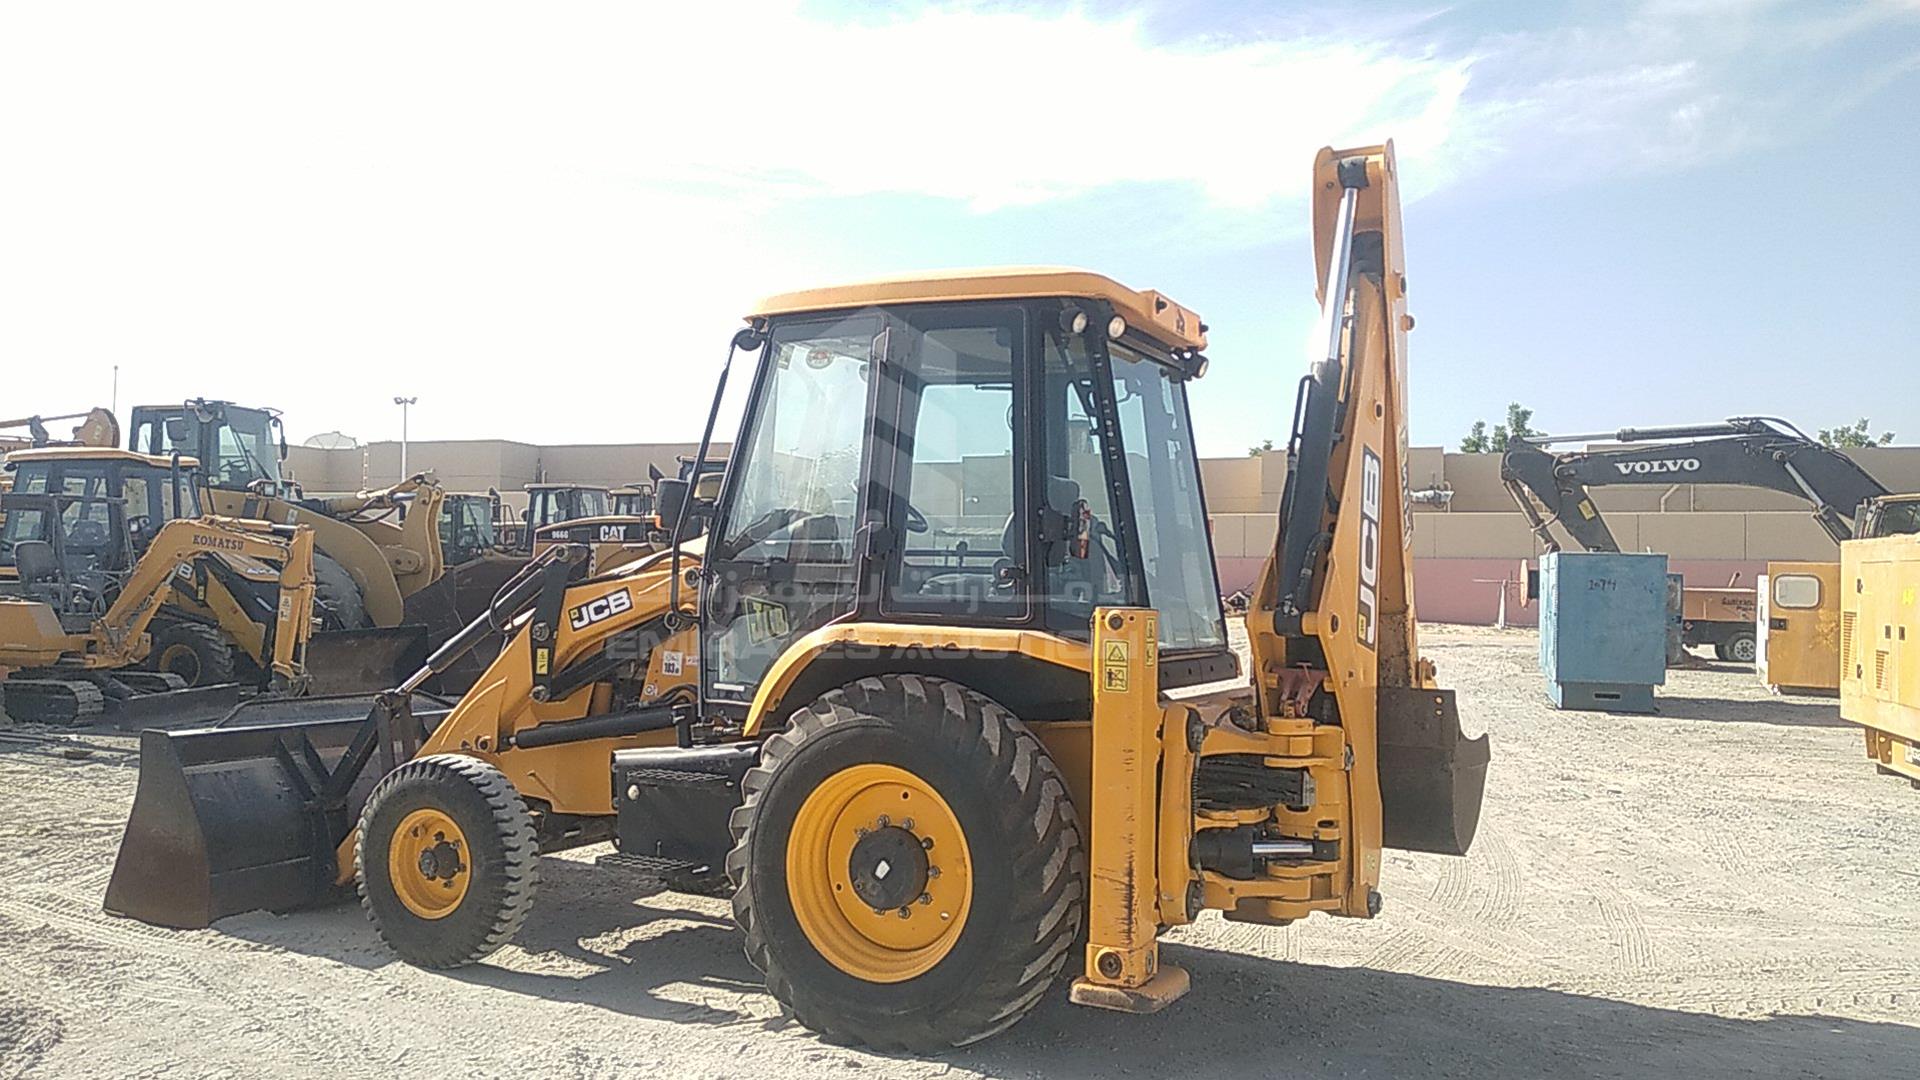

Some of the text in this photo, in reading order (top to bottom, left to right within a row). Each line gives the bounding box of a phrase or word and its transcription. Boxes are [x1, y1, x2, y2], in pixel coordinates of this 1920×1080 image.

[1614, 458, 1700, 474] VOLVO
[600, 525, 626, 541] CAT
[192, 534, 244, 550] KOMATSU
[1359, 452, 1380, 645] JCB
[573, 591, 631, 629] JCB
